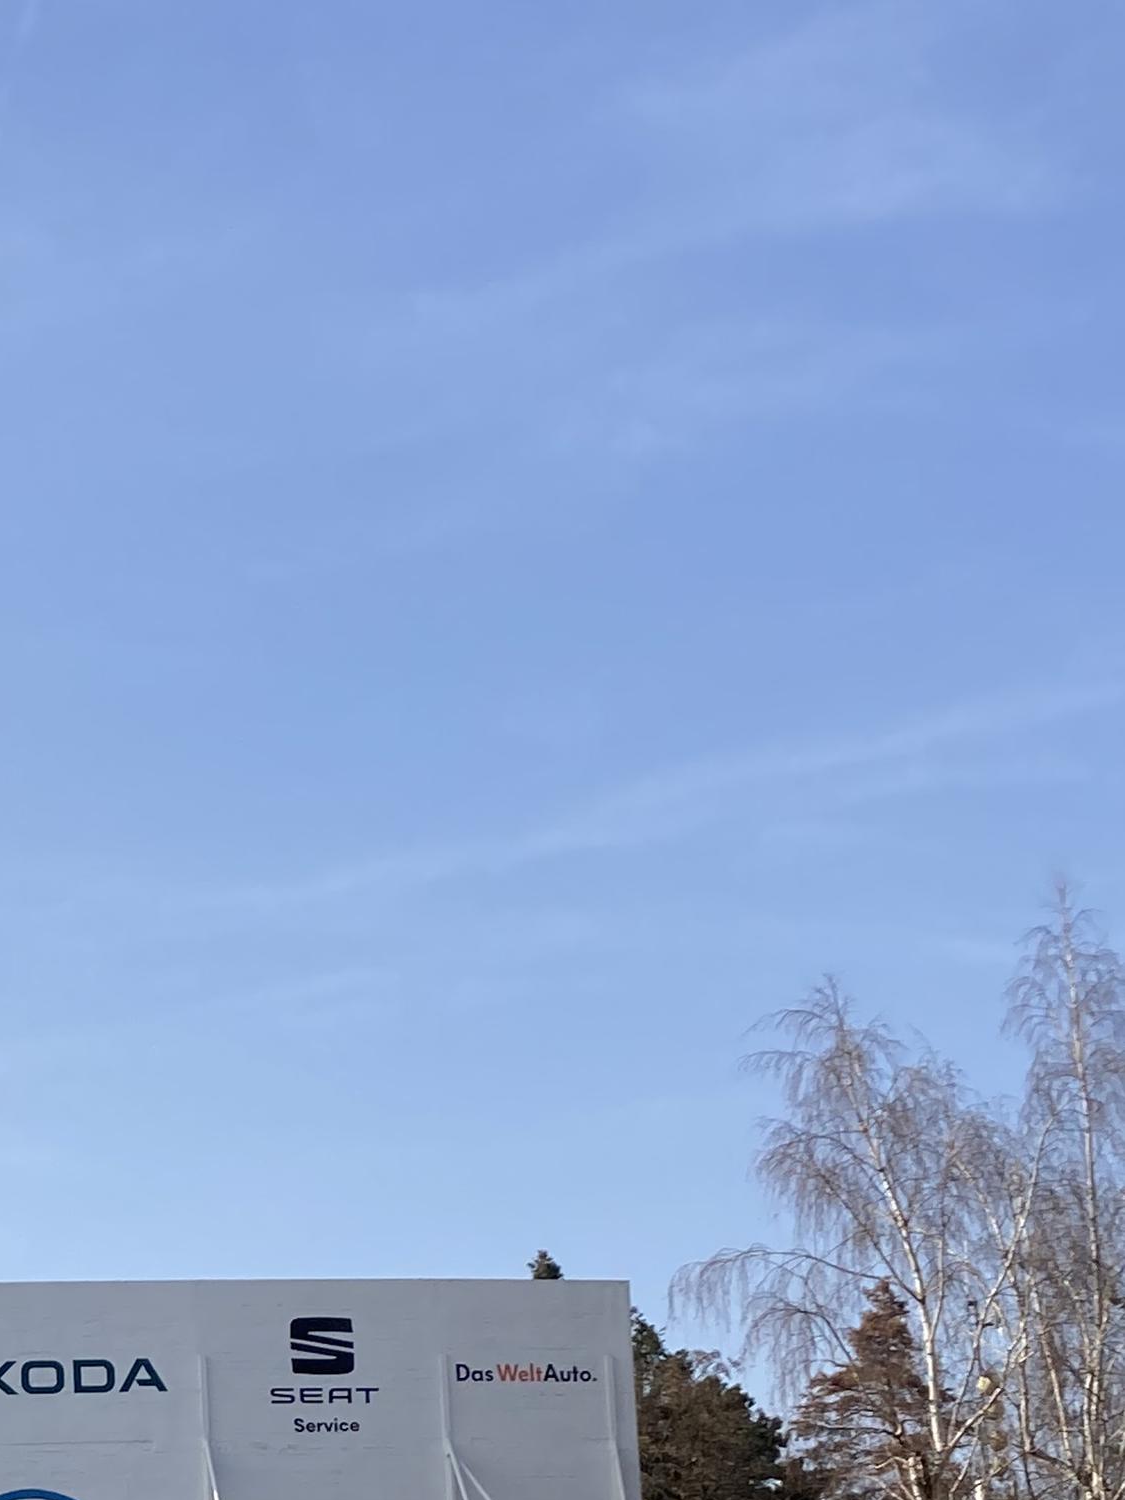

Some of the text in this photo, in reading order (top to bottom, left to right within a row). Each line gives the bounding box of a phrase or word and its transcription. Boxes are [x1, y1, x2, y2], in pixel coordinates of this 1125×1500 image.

[456, 1364, 494, 1382] Das
[271, 1388, 379, 1404] SEAT
[293, 1417, 360, 1433] Service
